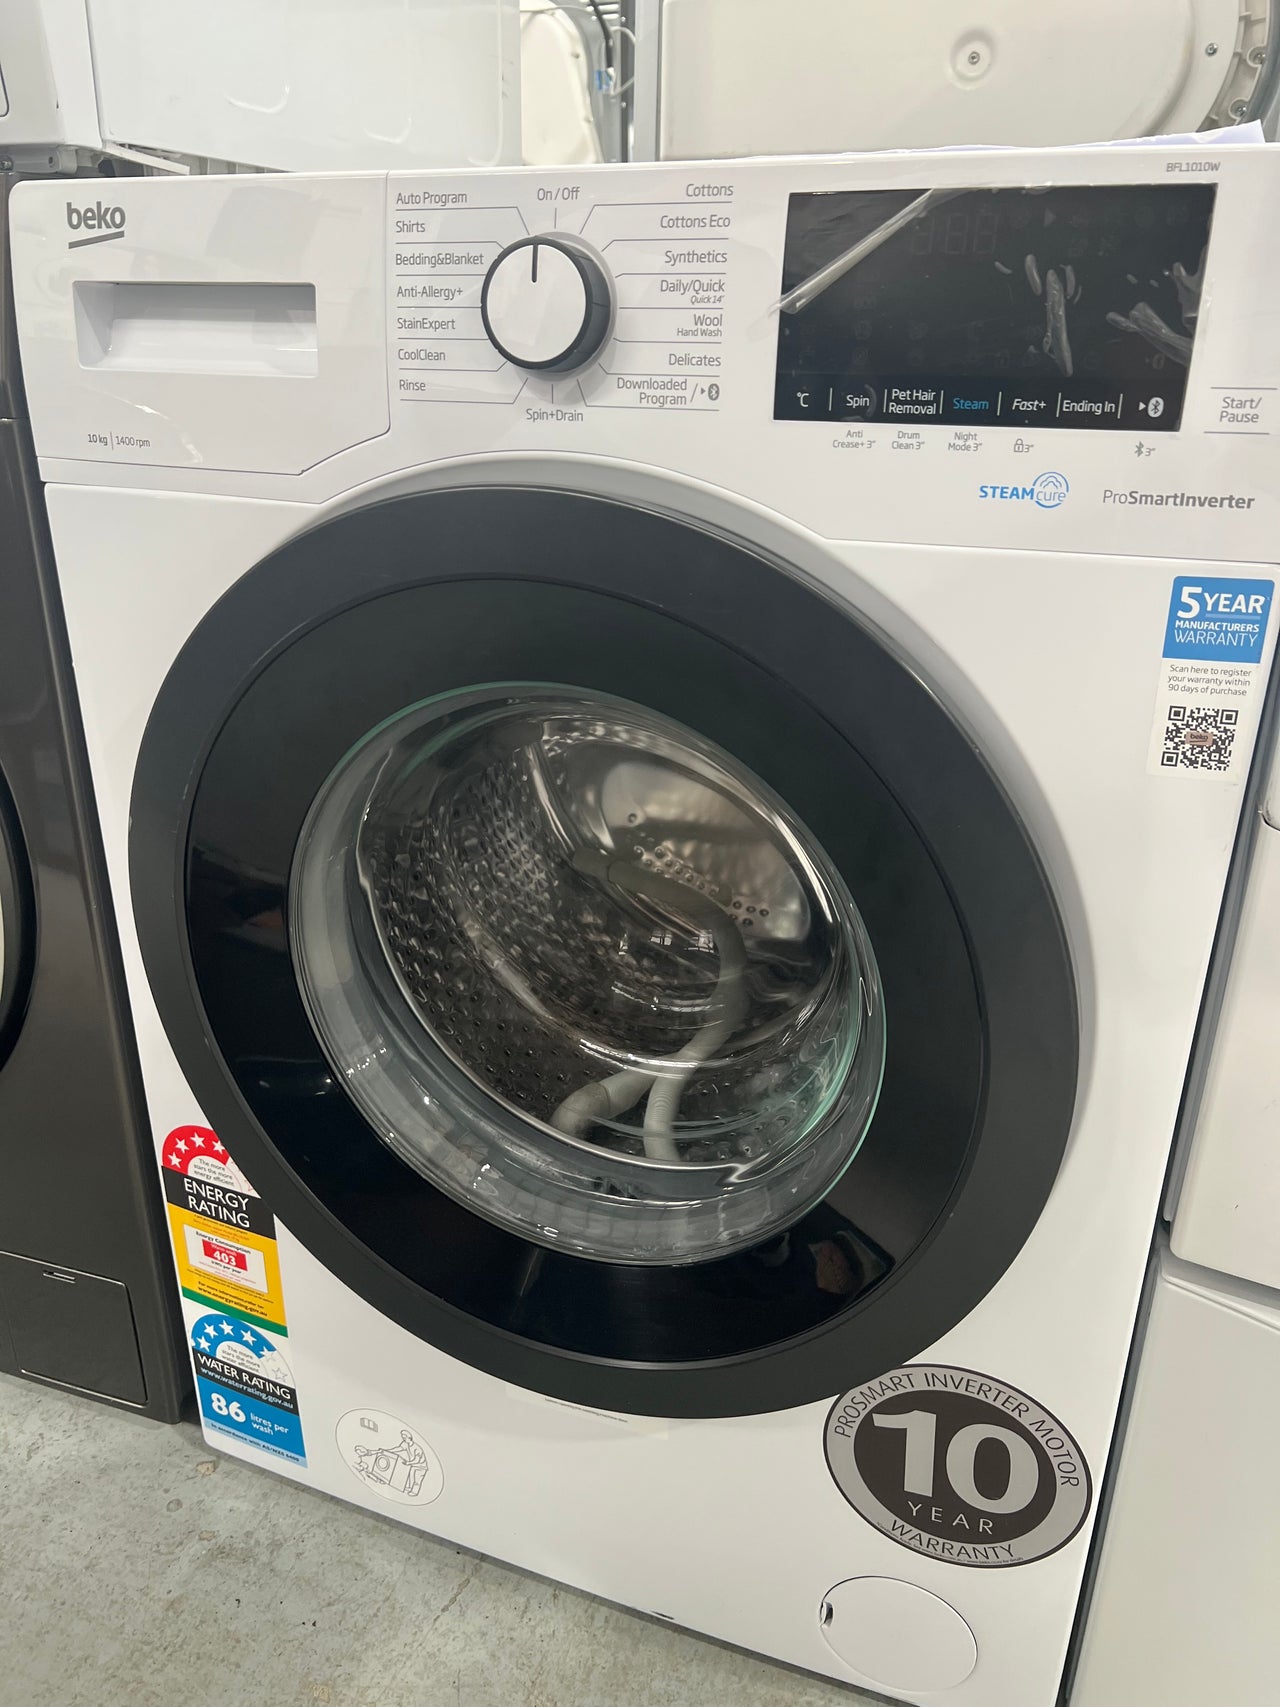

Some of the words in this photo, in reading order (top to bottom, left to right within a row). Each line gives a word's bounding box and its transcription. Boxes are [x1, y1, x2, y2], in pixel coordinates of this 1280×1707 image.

[1166, 161, 1220, 172] BFL1010W
[537, 188, 552, 201] On
[561, 187, 580, 201] Off
[686, 183, 734, 198] Cottons
[396, 192, 421, 205] Auto
[423, 191, 468, 207] Program
[66, 201, 126, 229] beko
[395, 221, 426, 233] Shirts
[660, 215, 707, 230] Cottons
[709, 215, 731, 229] Eco
[395, 252, 484, 268] Bedding&Blanket
[664, 250, 728, 266] Synthetics
[397, 285, 463, 300] Anti-Allergy+
[660, 279, 725, 295] Daily/Quick
[690, 295, 712, 305] Quick
[397, 317, 456, 331] StainExpert
[694, 313, 723, 327] Wool
[677, 327, 699, 337] Hand
[700, 327, 722, 337] Wash
[398, 348, 446, 361] CoolClean
[668, 353, 722, 367] Delicates
[399, 379, 427, 392] Rinse
[616, 377, 688, 391] Downloaded
[639, 393, 687, 408] Program
[846, 394, 870, 409] Spin
[891, 388, 912, 401] Pet
[913, 389, 936, 402] Hair
[888, 402, 937, 415] Removal
[953, 397, 990, 411] Steam
[1012, 398, 1047, 412] Fast+
[1062, 400, 1102, 415] Ending
[1104, 400, 1116, 414] In
[1222, 396, 1263, 410] Start/
[526, 408, 584, 424] Spin+Drain
[1219, 410, 1260, 424] Pause
[88, 434, 98, 443] 10
[99, 434, 108, 446] kg
[846, 429, 864, 439] Anti
[897, 430, 921, 440] Drum
[954, 432, 978, 443] Night
[115, 435, 135, 446] 1400
[135, 439, 151, 449] rpm
[832, 439, 866, 450] Crease+
[891, 440, 915, 450] Clean
[947, 442, 972, 452] Mode
[1102, 489, 1255, 509] ProSmartInverter
[1176, 586, 1203, 619] 5
[1203, 592, 1266, 614] YEAR
[1175, 620, 1260, 633] MANUFACTURERS
[1173, 629, 1259, 647] WARRANTY
[1170, 664, 1189, 673] Scan
[1190, 666, 1209, 674] here
[1210, 667, 1219, 675] to
[1220, 668, 1252, 678] register
[1167, 674, 1186, 684] your
[1187, 676, 1223, 687] warranty
[1222, 678, 1251, 687] within
[1168, 683, 1180, 691] 90
[1180, 684, 1199, 694] days
[1200, 685, 1210, 694] of
[1210, 687, 1247, 697] purchase
[183, 1177, 249, 1211] ENERGY
[188, 1195, 250, 1228] RATING
[195, 1230, 214, 1243] Energy
[214, 1237, 252, 1255] Consumption
[213, 1250, 237, 1266] 403
[197, 1353, 240, 1380] WATER
[241, 1372, 291, 1400] RATING
[200, 1366, 294, 1409] www.waterrating.gov.au
[210, 1392, 247, 1423] 86
[250, 1412, 272, 1428] litres
[273, 1422, 289, 1435] per
[251, 1421, 274, 1437] wash
[834, 1372, 915, 1438] PROSMART
[923, 1372, 1031, 1419] INVERTER
[1029, 1418, 1080, 1488] MOTOR
[871, 1409, 1039, 1514] 10
[906, 1500, 994, 1535] YEAR
[890, 1519, 1014, 1560] WARRANTY
